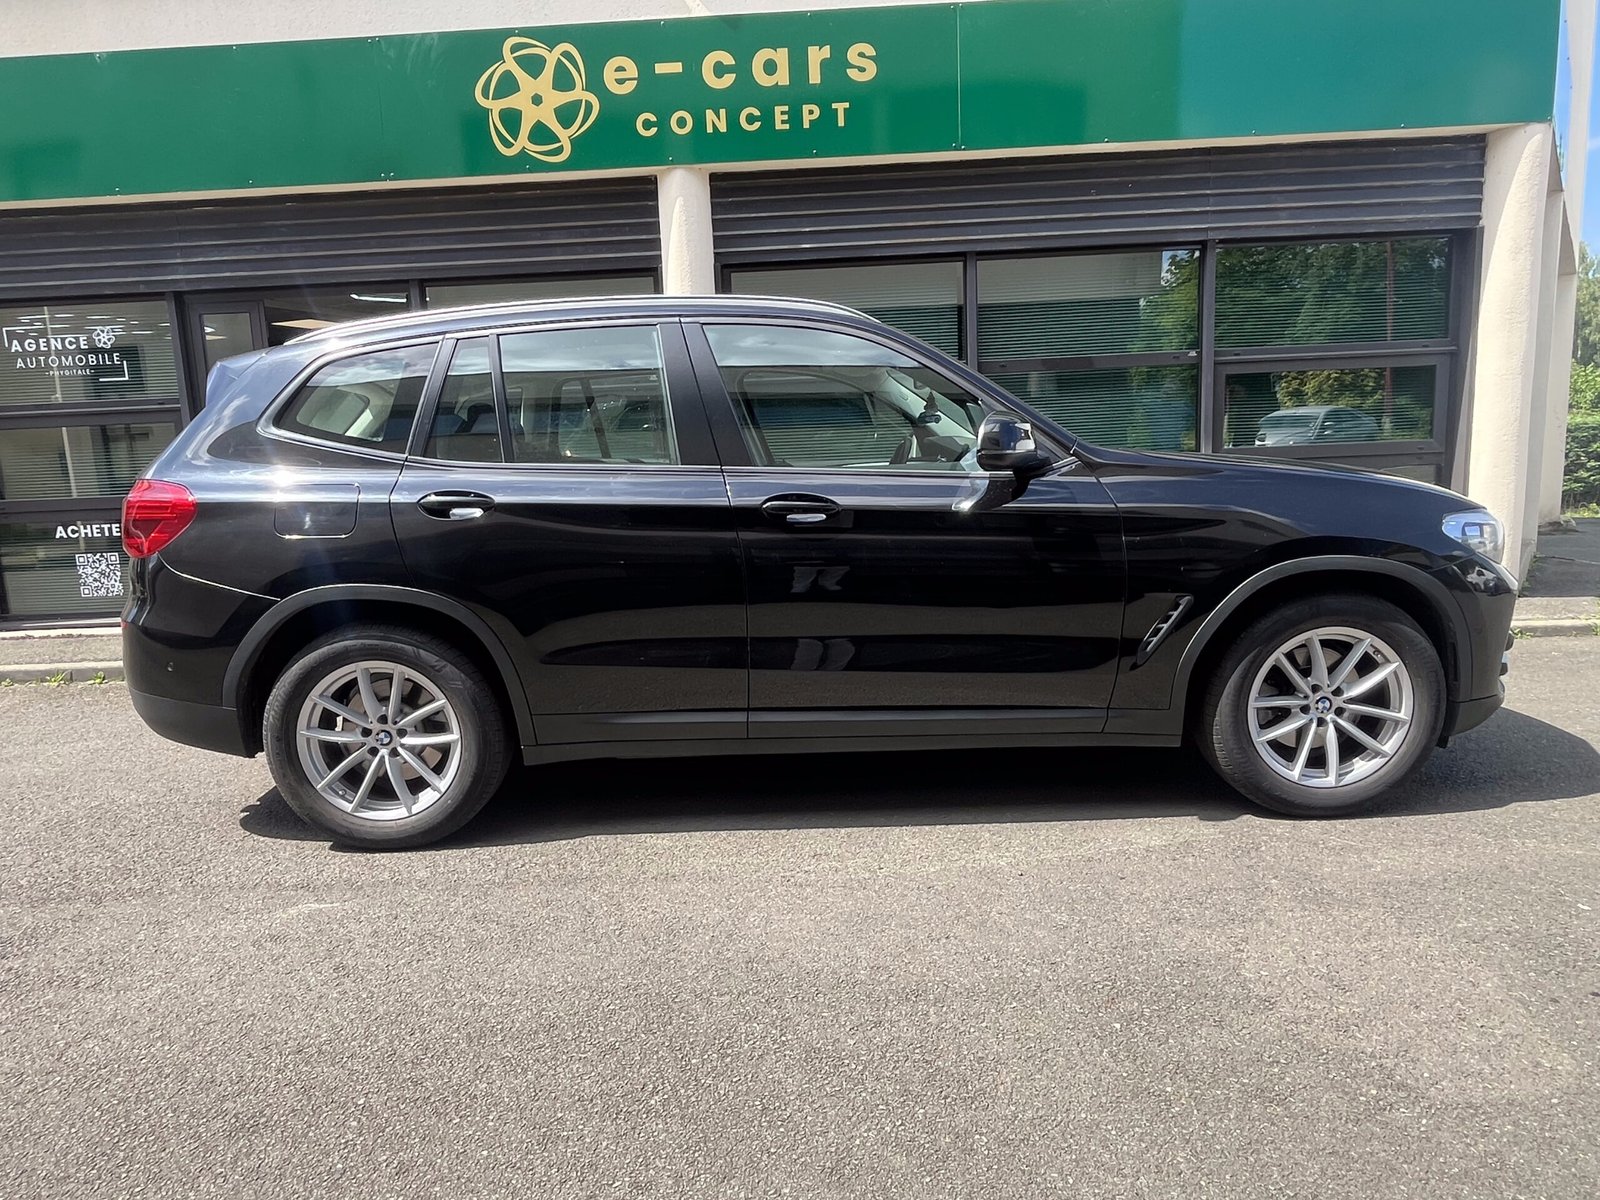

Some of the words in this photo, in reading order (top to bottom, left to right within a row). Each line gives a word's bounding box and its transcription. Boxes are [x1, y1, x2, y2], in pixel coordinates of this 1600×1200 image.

[603, 42, 877, 95] e-cars
[635, 102, 850, 137] CONCEPT
[11, 336, 89, 352] AGENCE
[16, 353, 121, 368] AUTOMOBILE
